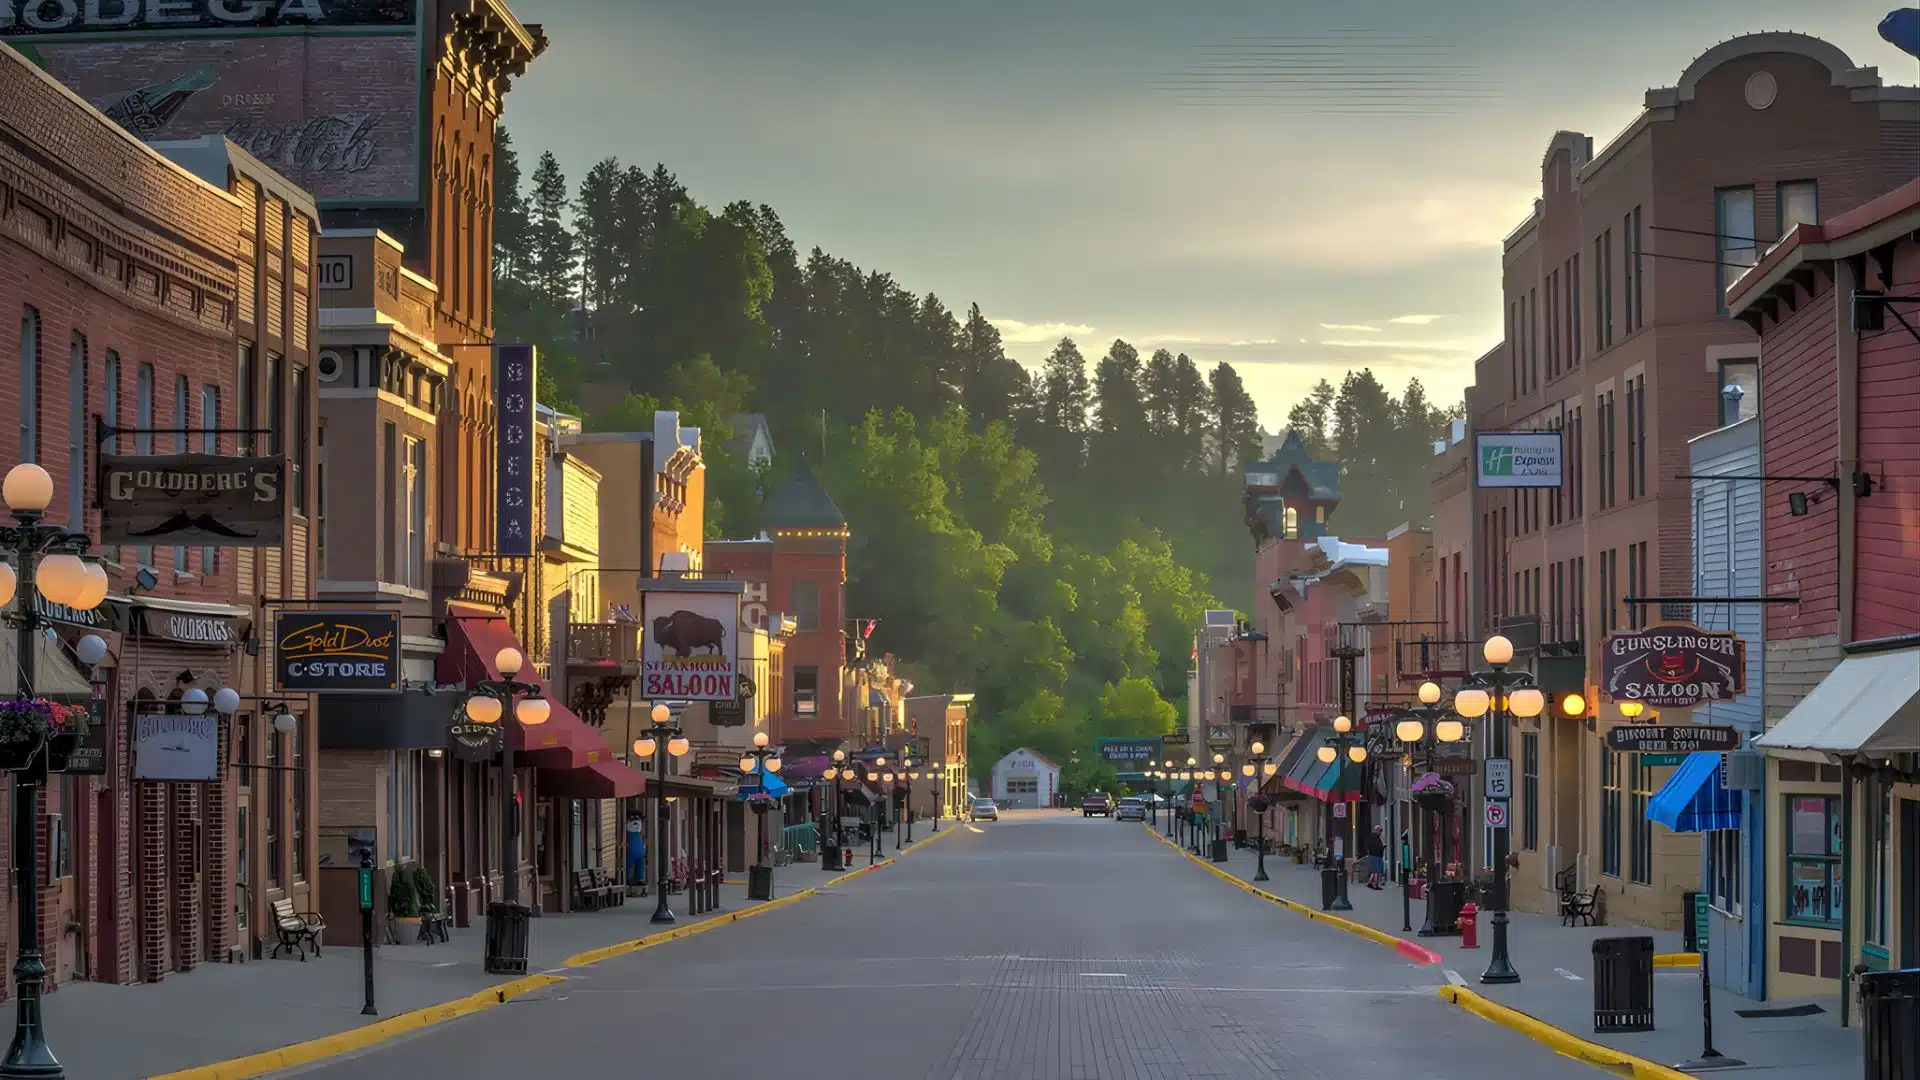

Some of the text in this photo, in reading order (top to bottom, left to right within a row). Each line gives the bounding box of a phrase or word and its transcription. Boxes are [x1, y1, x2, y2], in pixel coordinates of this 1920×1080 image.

[0, 0, 326, 28] ODEGA
[110, 466, 277, 502] GOLDBERG'S
[280, 622, 395, 652] Gold Dust
[1612, 636, 1735, 656] GUNSLINGER
[647, 674, 733, 697] SALOON
[1625, 682, 1720, 699] SALOON
[1492, 779, 1504, 793] 15
